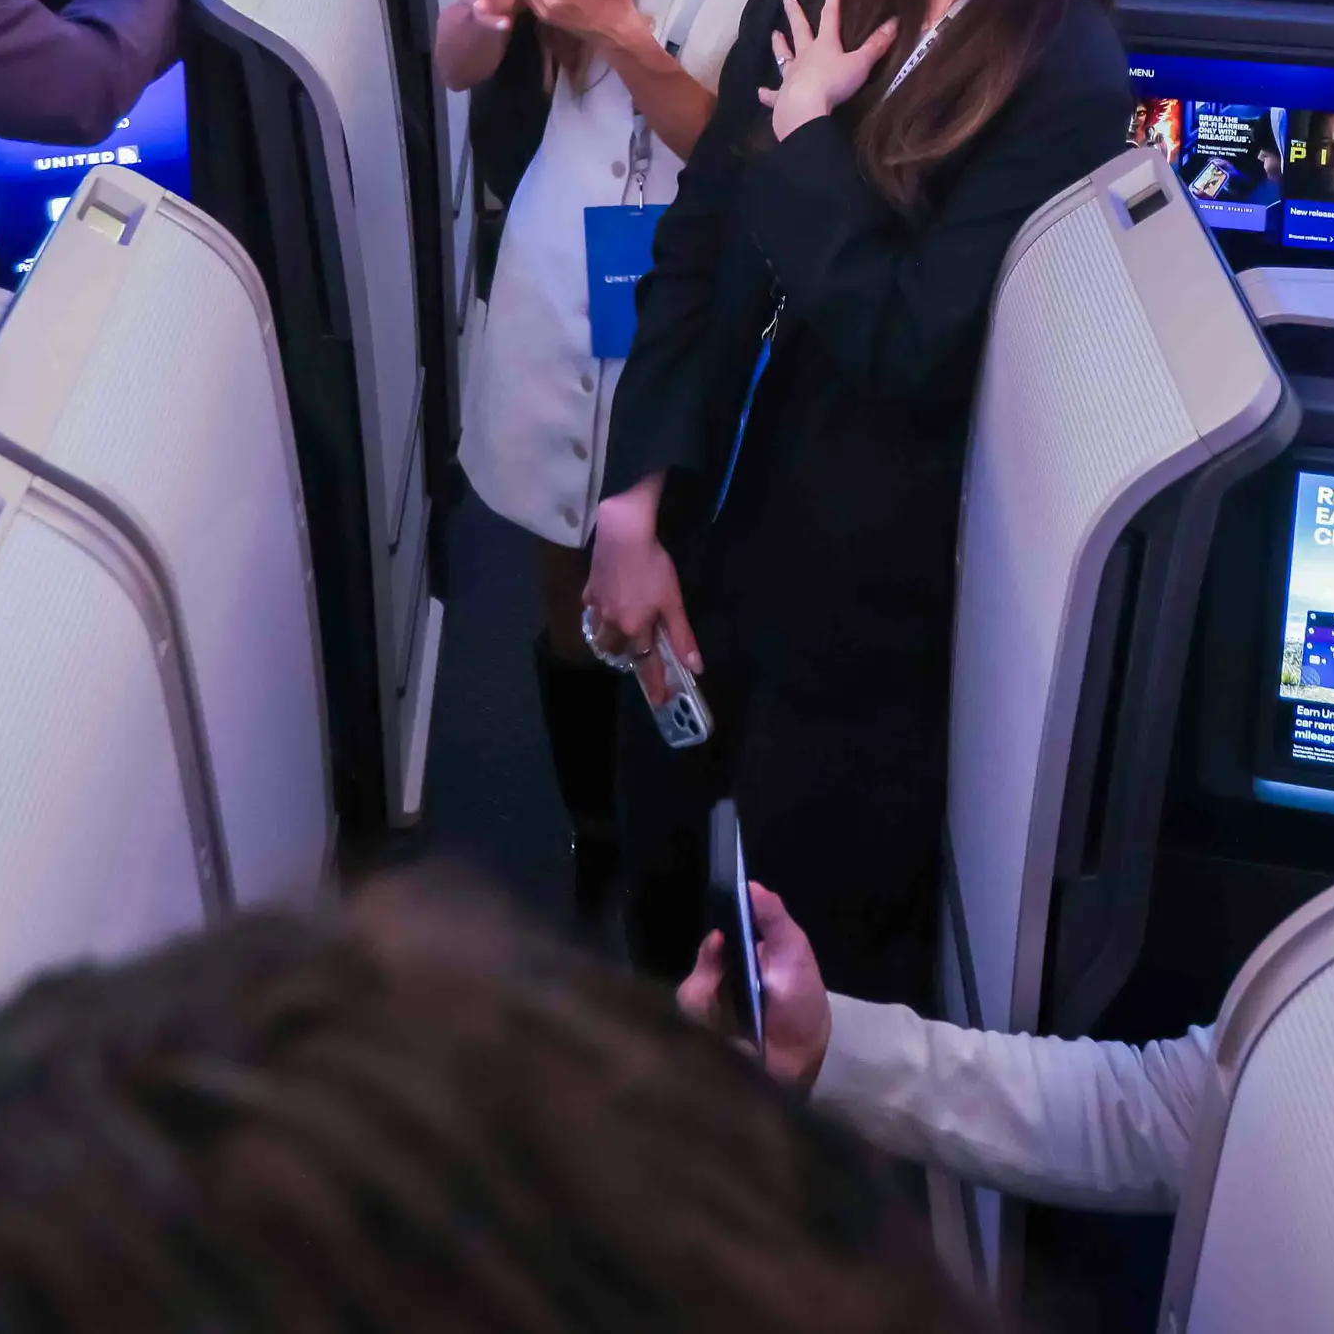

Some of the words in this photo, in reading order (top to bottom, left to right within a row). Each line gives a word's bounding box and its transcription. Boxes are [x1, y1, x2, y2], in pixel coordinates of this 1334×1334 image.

[1128, 67, 1155, 78] MENU
[1198, 114, 1224, 122] BREAK
[1224, 116, 1238, 124] THE
[1198, 121, 1217, 129] WI-FI
[1217, 123, 1251, 131] BARRIER.
[1198, 127, 1217, 135] ONLY
[35, 151, 115, 170] UNITED
[1290, 207, 1308, 216] New
[604, 274, 643, 284] UNIT
[1297, 705, 1320, 717] Earn
[1295, 718, 1313, 728] car
